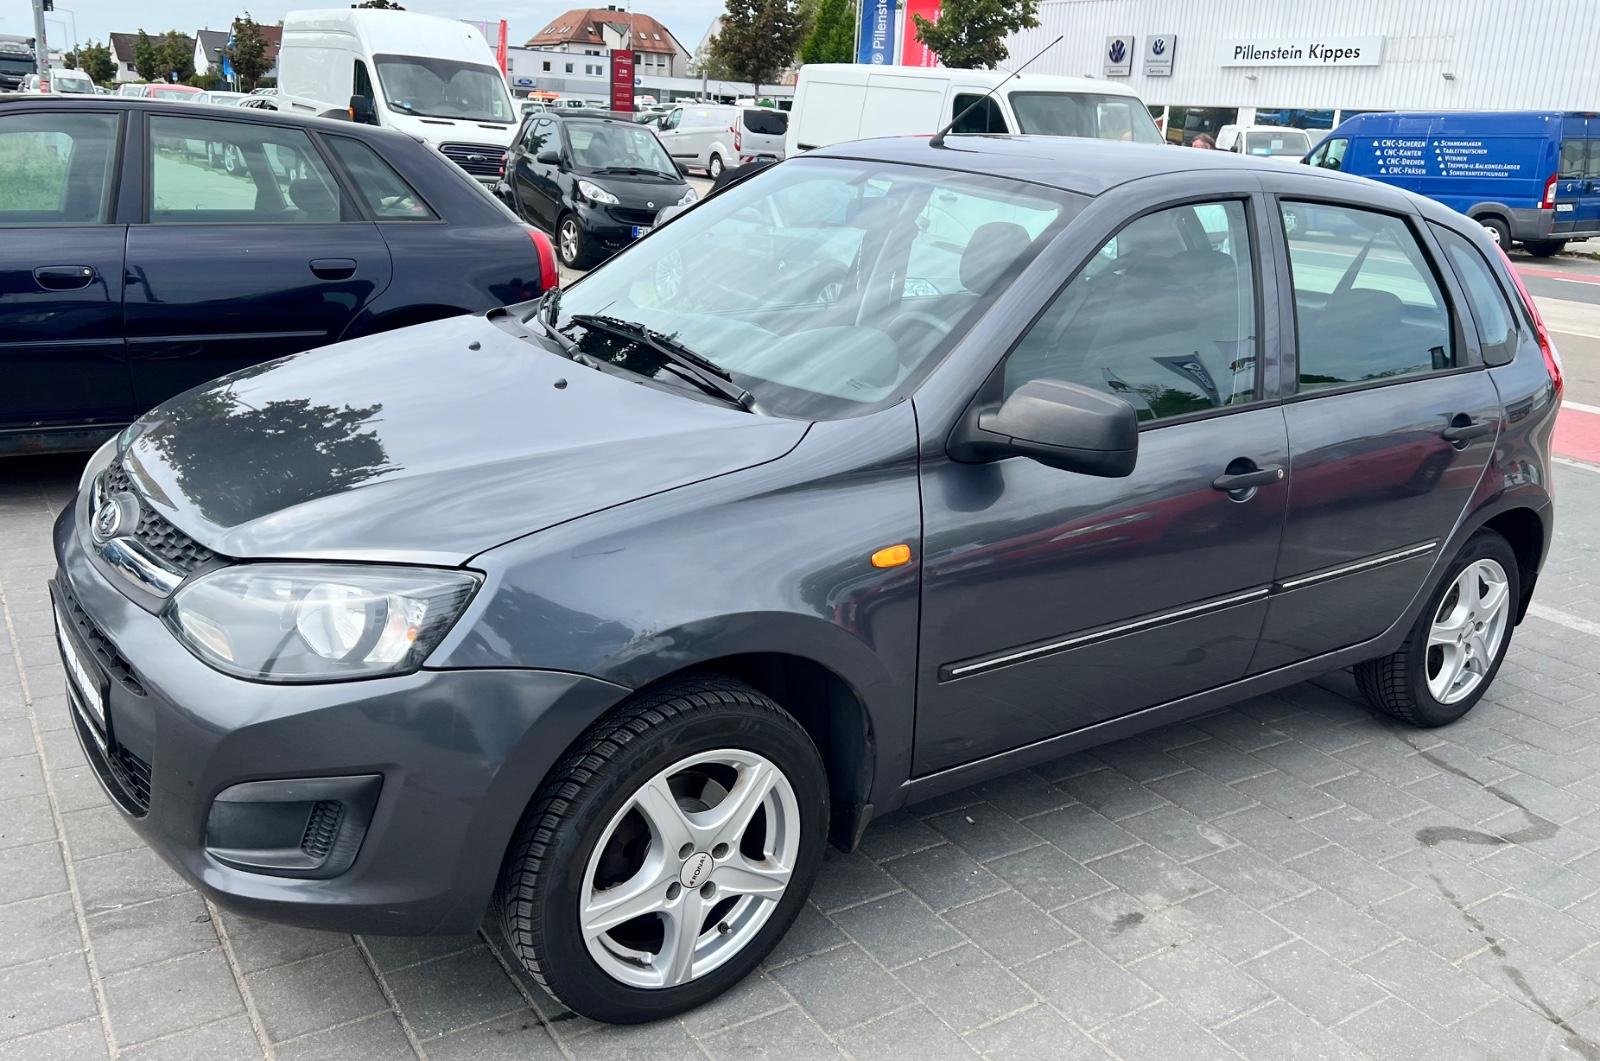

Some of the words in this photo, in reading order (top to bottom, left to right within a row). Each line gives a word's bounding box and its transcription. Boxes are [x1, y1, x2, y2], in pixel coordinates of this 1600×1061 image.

[1234, 44, 1302, 60] Pillenstein
[1308, 43, 1361, 62] Kippes
[692, 855, 706, 879] RONAL
